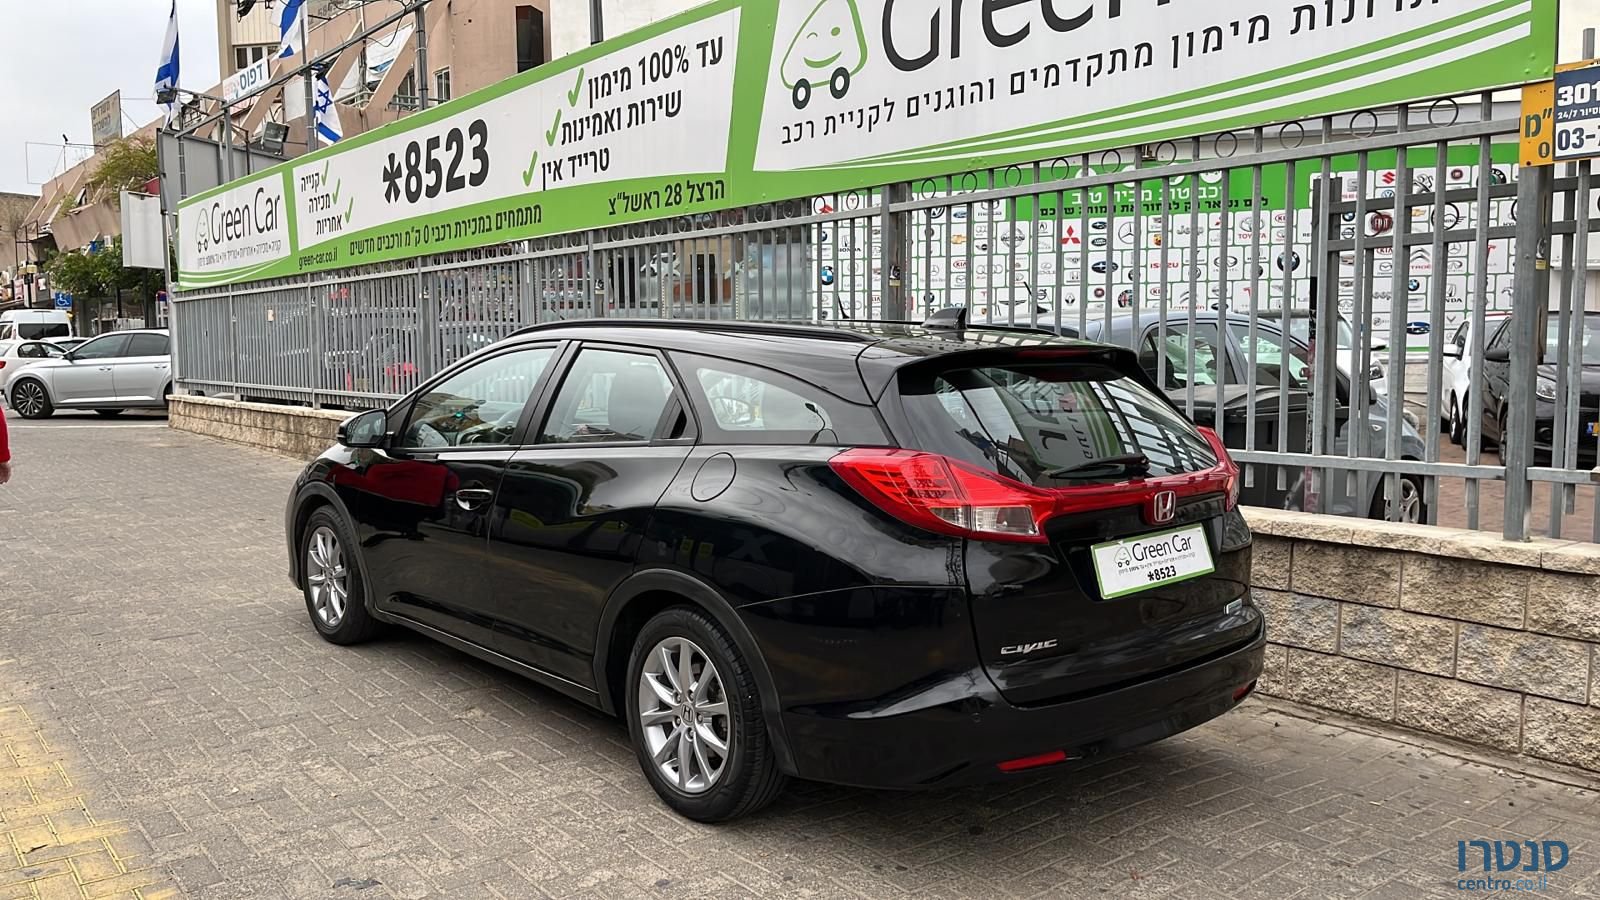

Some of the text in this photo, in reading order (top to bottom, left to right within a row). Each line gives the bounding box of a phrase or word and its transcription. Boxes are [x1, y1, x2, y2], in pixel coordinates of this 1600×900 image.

[239, 63, 262, 90] דפוס
[588, 36, 724, 109] עד 100% מימון
[781, 0, 1439, 144] ונות מימון מתקדמים והוגנים לקניית רכב
[561, 89, 682, 146] שירות ואמינות
[1557, 109, 1578, 119] 24/7
[541, 147, 610, 191] טרייד אין
[301, 172, 320, 193] קנייה
[687, 177, 725, 204] הרצל
[309, 193, 331, 214] מכירה
[664, 183, 682, 208] 28
[211, 187, 280, 245] Green Car
[316, 214, 342, 236] אחריות
[454, 215, 493, 239] במכירת
[495, 204, 542, 230] מתמחים
[377, 232, 402, 252] ורכבים
[423, 225, 430, 244] 0
[431, 224, 452, 243] רכבי
[299, 246, 338, 270] green-car.co.il
[350, 236, 375, 256] חדשים
[1132, 541, 1171, 562] Green
[1172, 534, 1192, 553] Car
[1000, 638, 1058, 655] CIVIC
